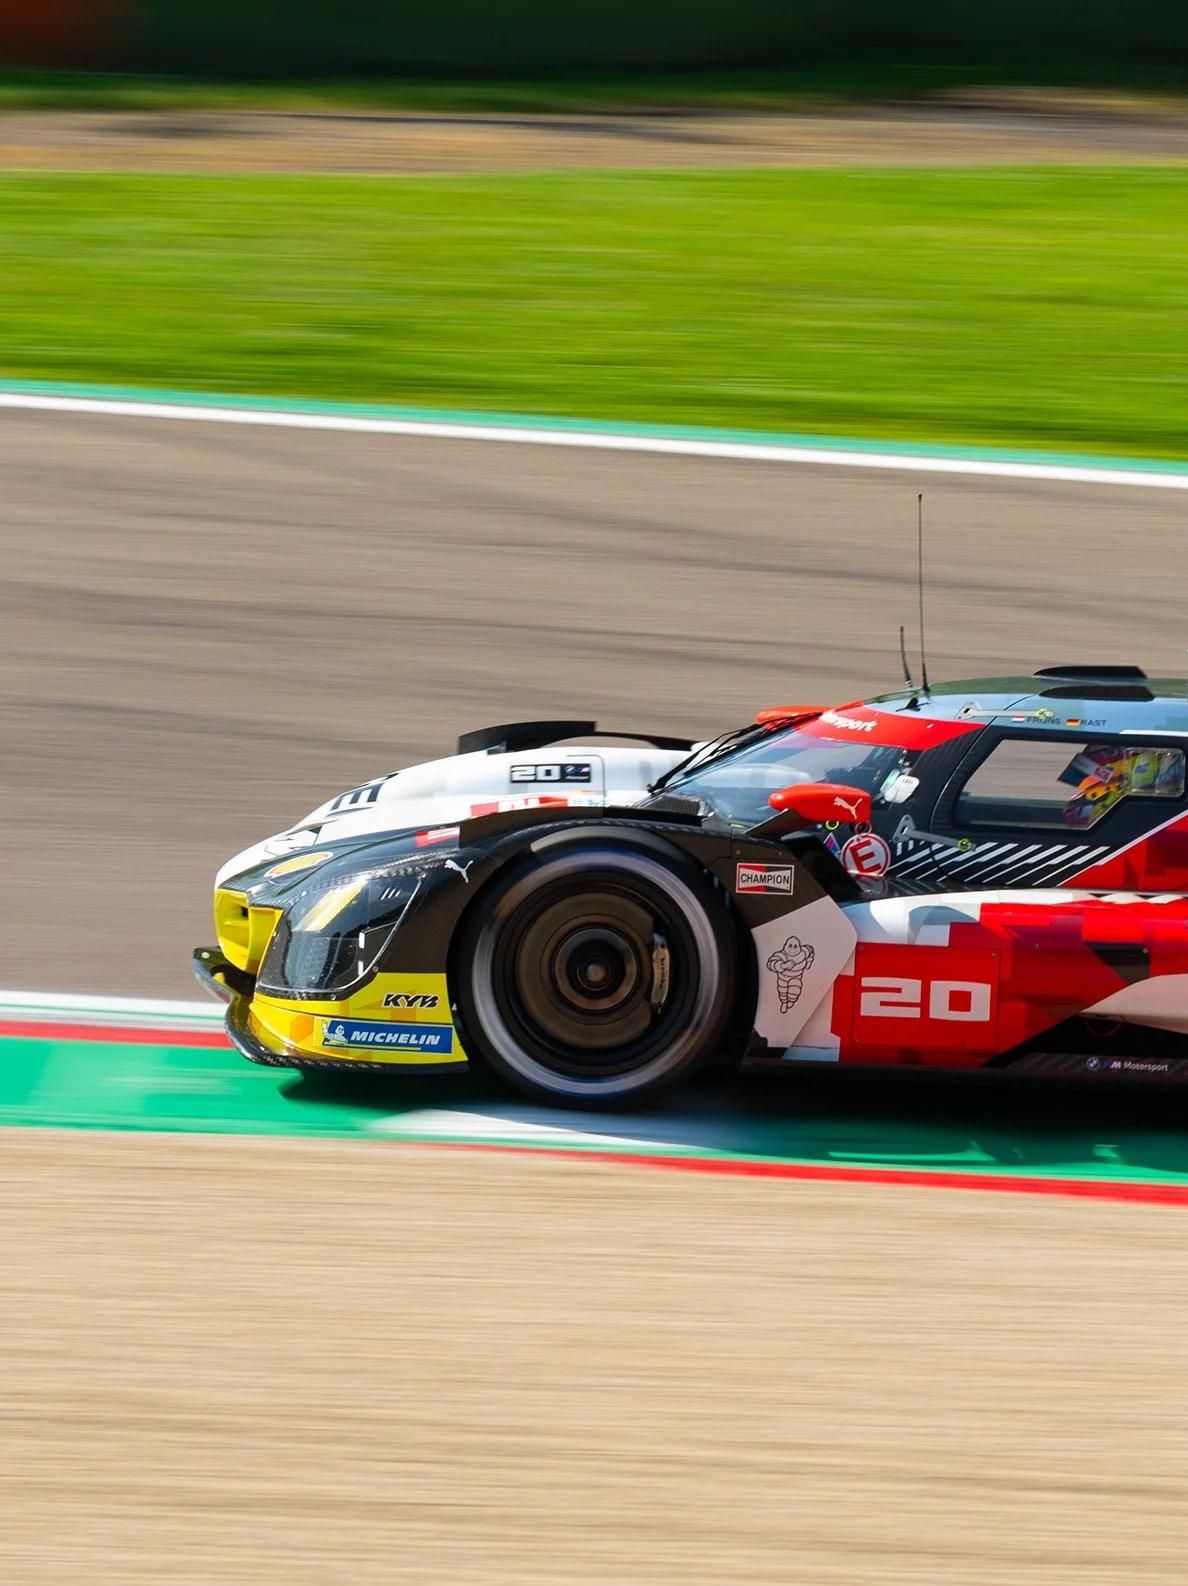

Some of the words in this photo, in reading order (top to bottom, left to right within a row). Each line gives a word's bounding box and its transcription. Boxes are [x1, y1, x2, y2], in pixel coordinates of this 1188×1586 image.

[1080, 719, 1107, 727] RAST
[511, 765, 561, 781] 20
[850, 840, 882, 873] E
[740, 873, 790, 885] CHAMPION
[382, 992, 440, 1008] KYB
[860, 977, 992, 1022] 20
[350, 1031, 441, 1045] MICHELIN
[1123, 1061, 1169, 1072] Motorsport
